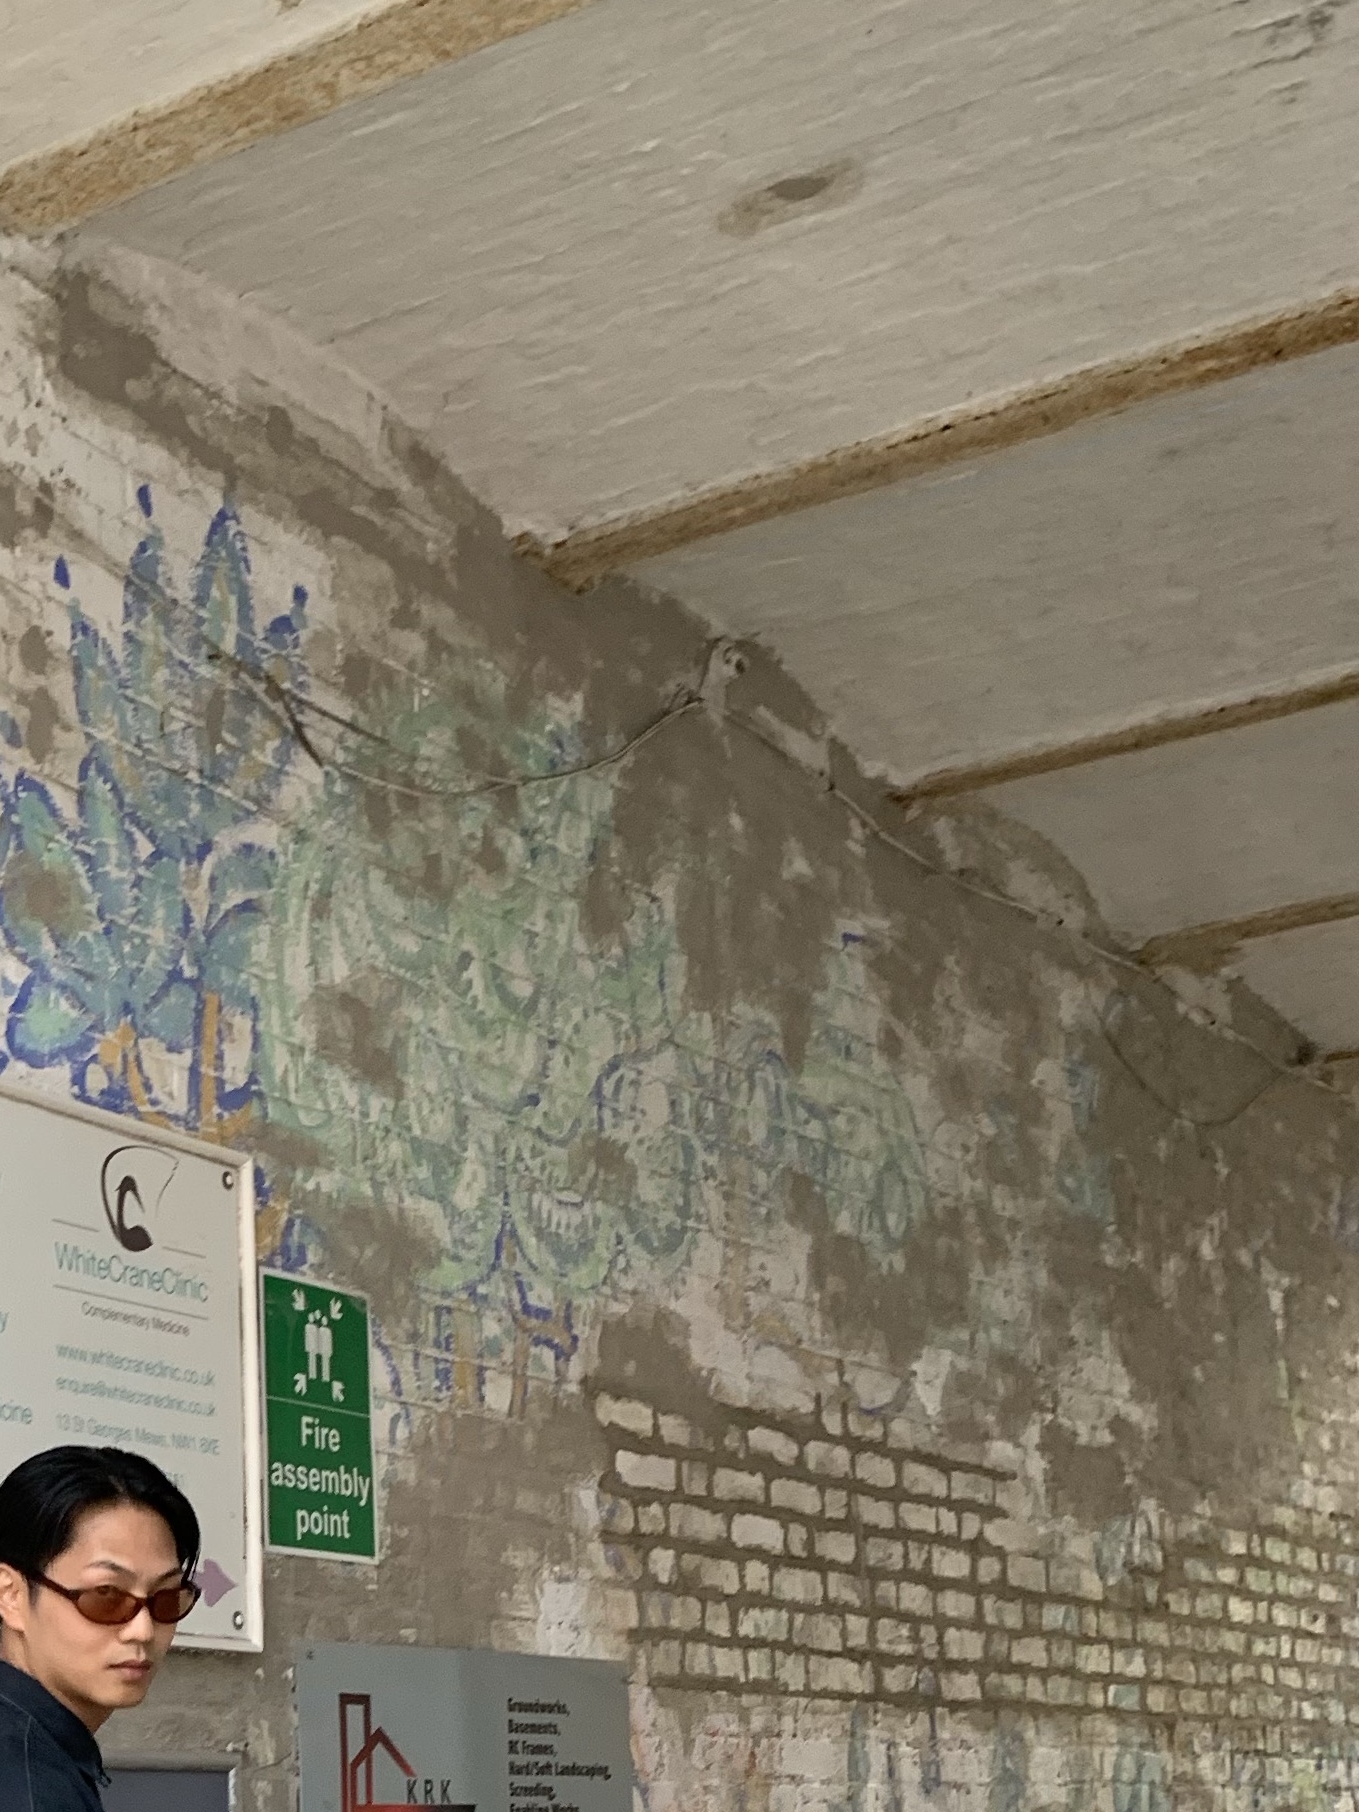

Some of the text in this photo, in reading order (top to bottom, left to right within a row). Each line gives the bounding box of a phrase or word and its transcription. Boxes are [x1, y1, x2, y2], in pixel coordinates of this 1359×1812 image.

[55, 1242, 209, 1302] WhiteCraneClinic
[301, 1415, 341, 1452] Fire
[270, 1460, 370, 1507] assembly
[296, 1505, 351, 1540] point
